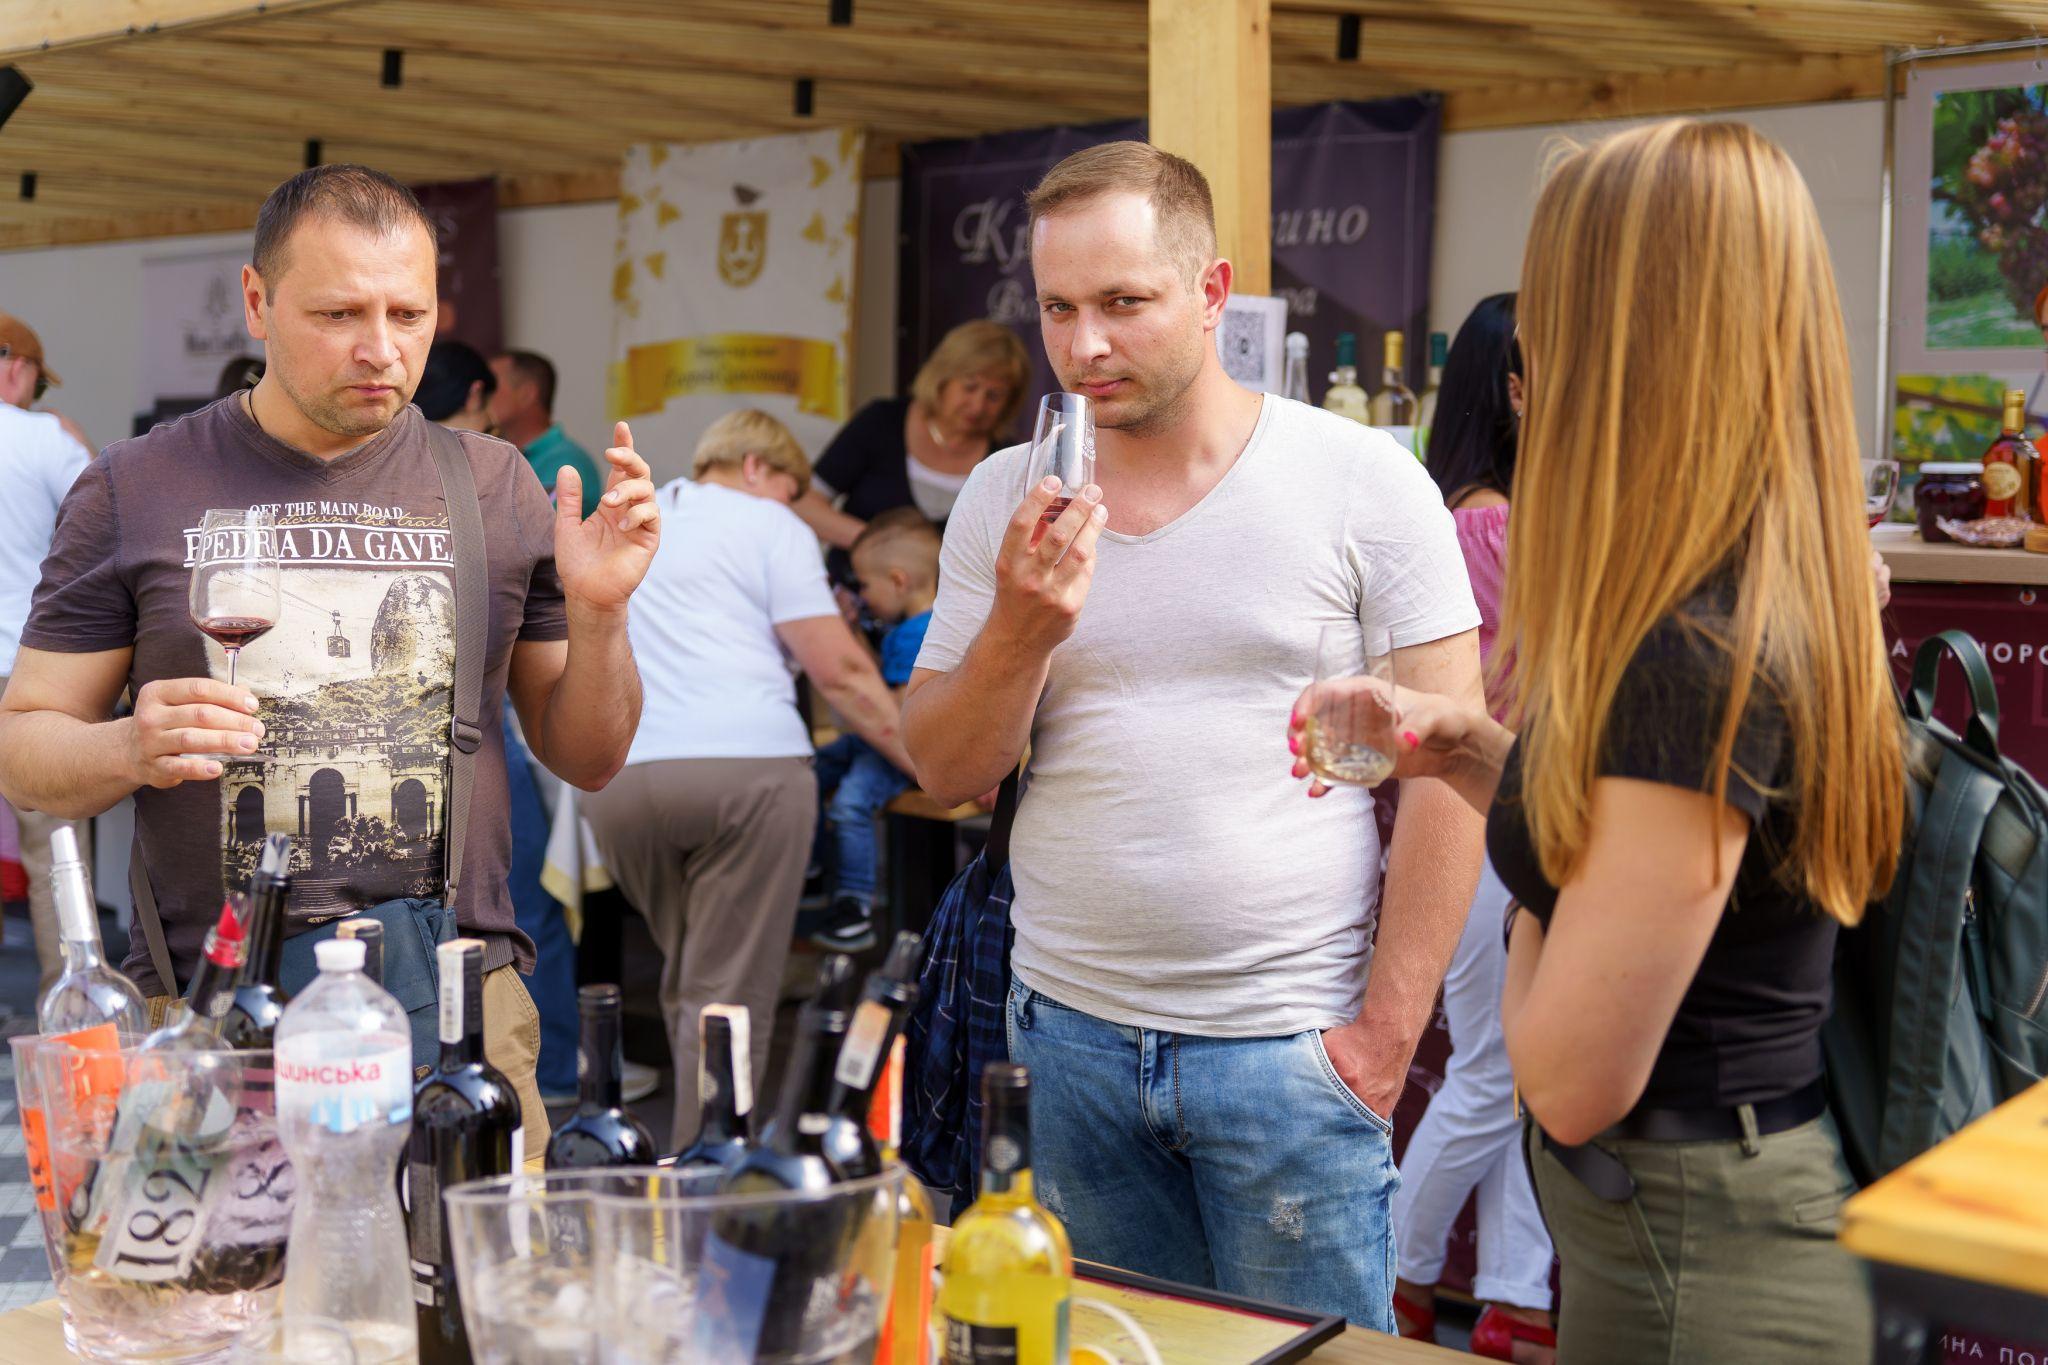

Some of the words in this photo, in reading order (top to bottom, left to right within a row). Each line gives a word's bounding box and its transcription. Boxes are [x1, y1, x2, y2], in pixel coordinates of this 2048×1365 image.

[1273, 203, 1369, 246] ино
[249, 503, 281, 519] OFF
[284, 501, 316, 517] THE
[320, 501, 359, 516] MAIN
[362, 503, 404, 520] ROAD
[354, 511, 390, 527] the
[308, 528, 356, 560] DA
[364, 531, 453, 562] GAVE
[275, 1058, 382, 1085] шинська
